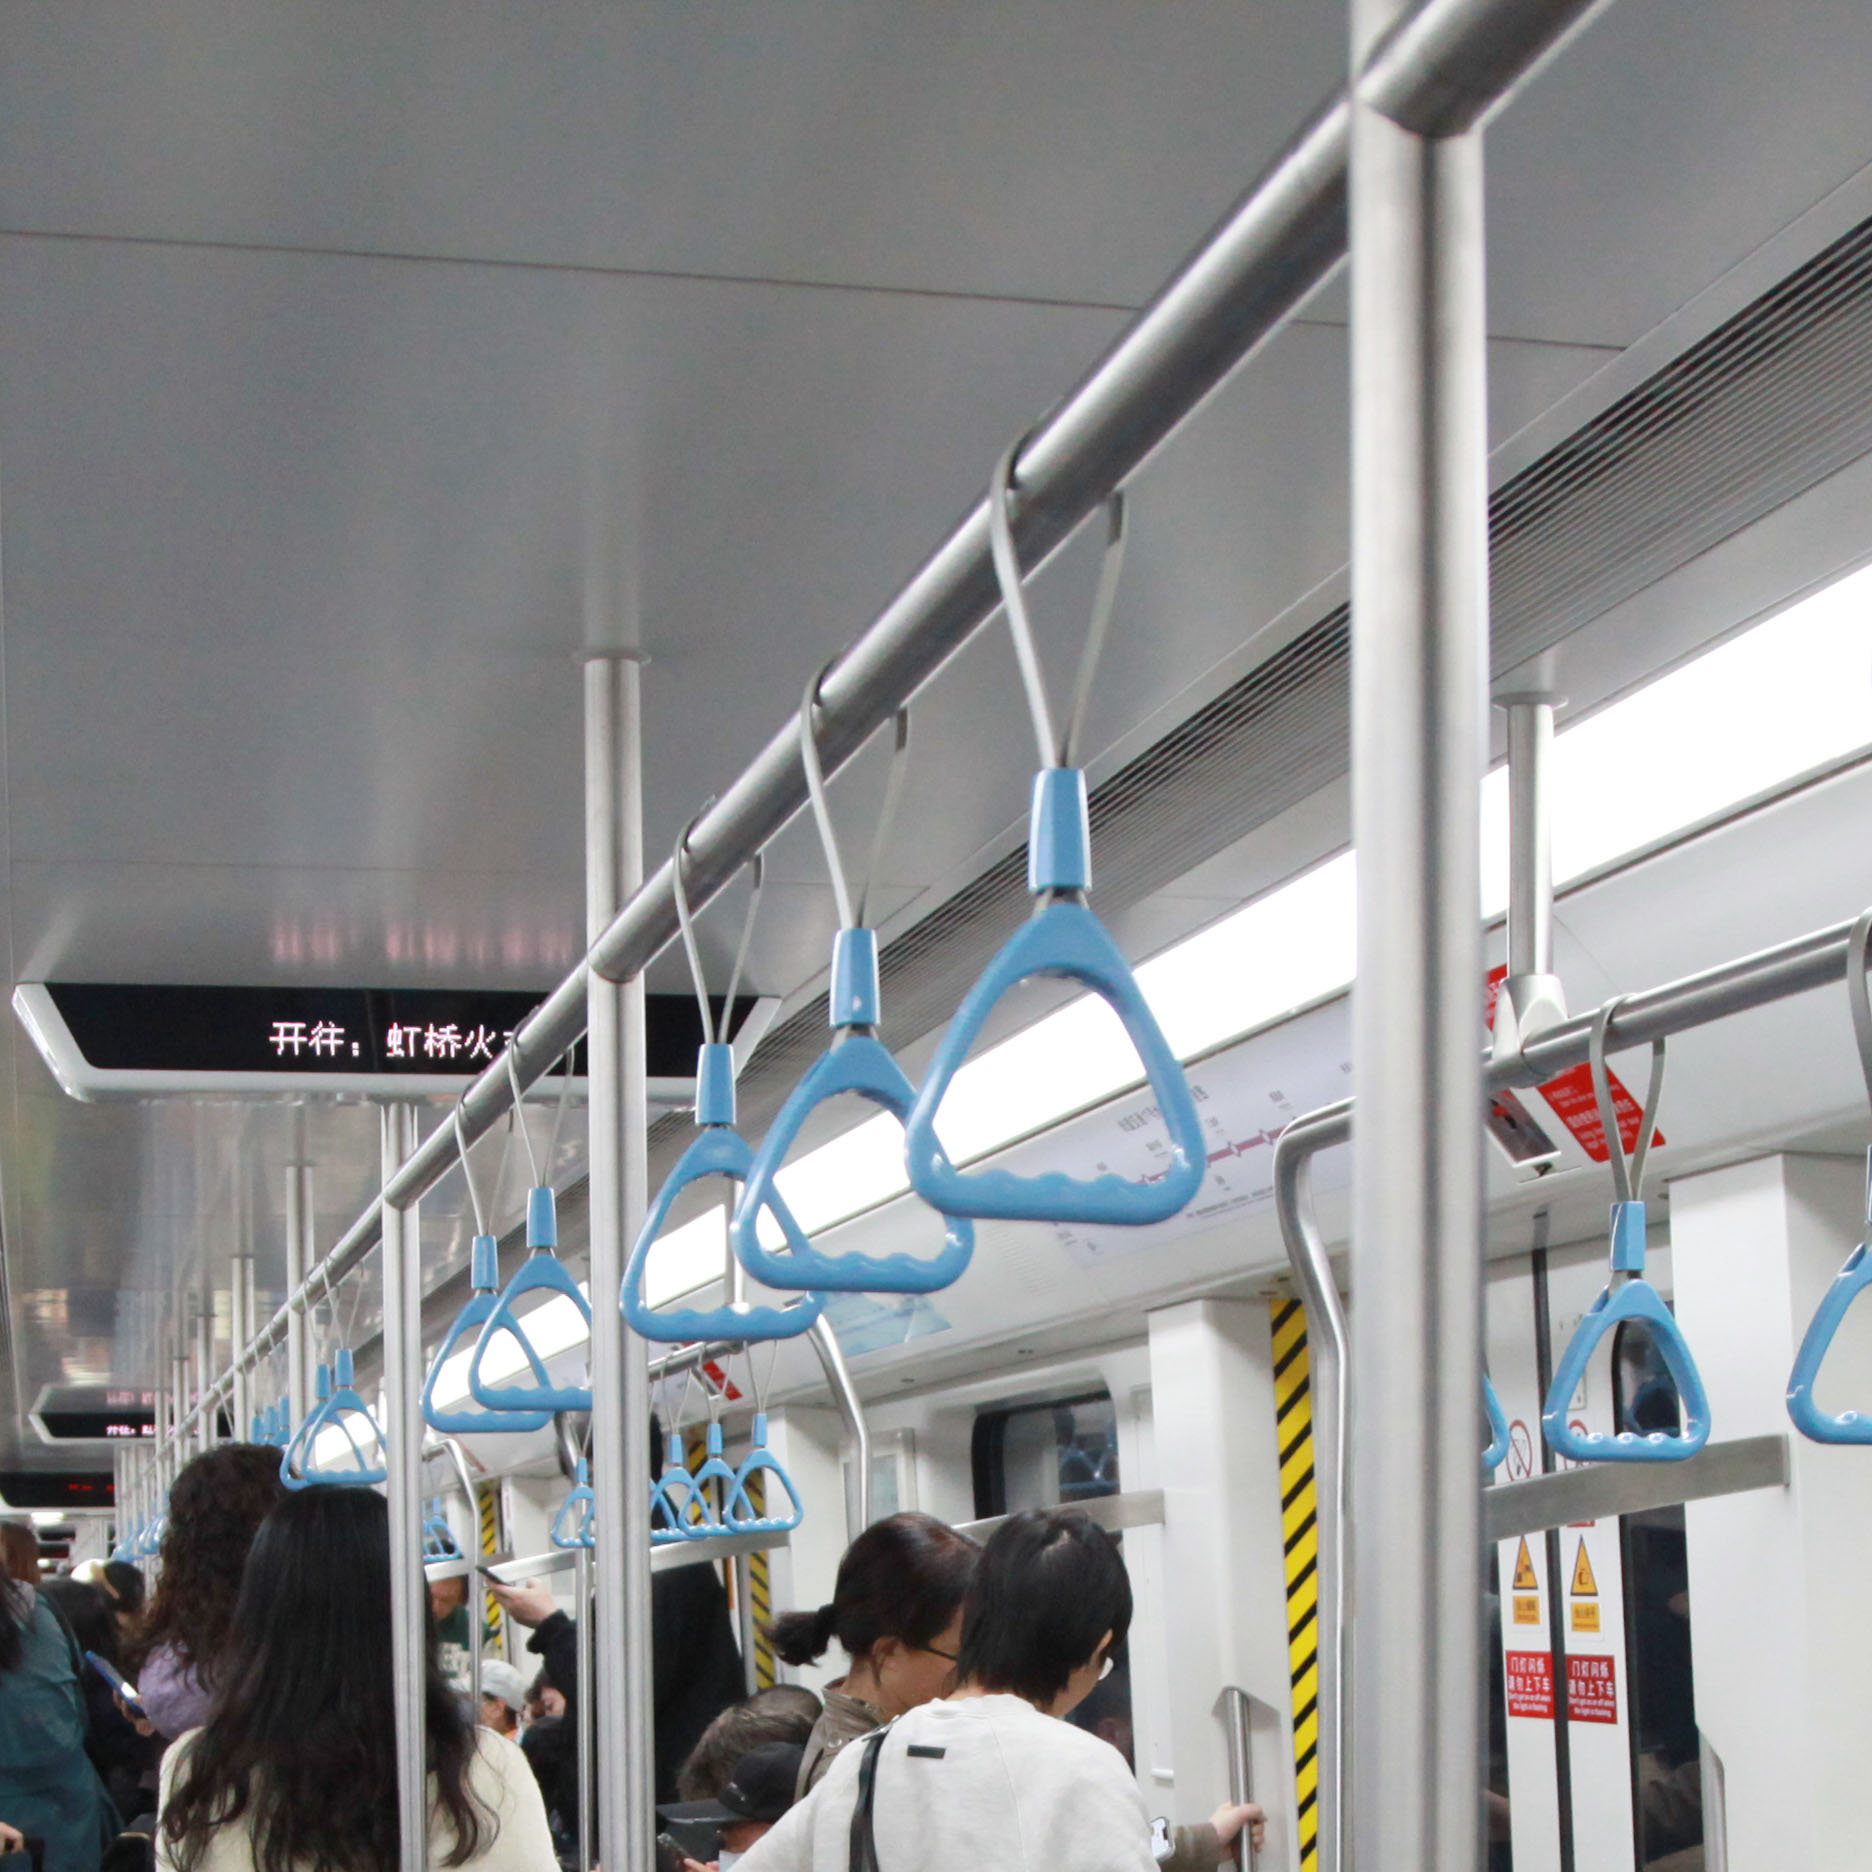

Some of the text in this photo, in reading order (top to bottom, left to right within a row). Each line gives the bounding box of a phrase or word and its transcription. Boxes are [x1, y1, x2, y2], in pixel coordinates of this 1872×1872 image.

[268, 1020, 514, 1059] 开往：虹桥火
